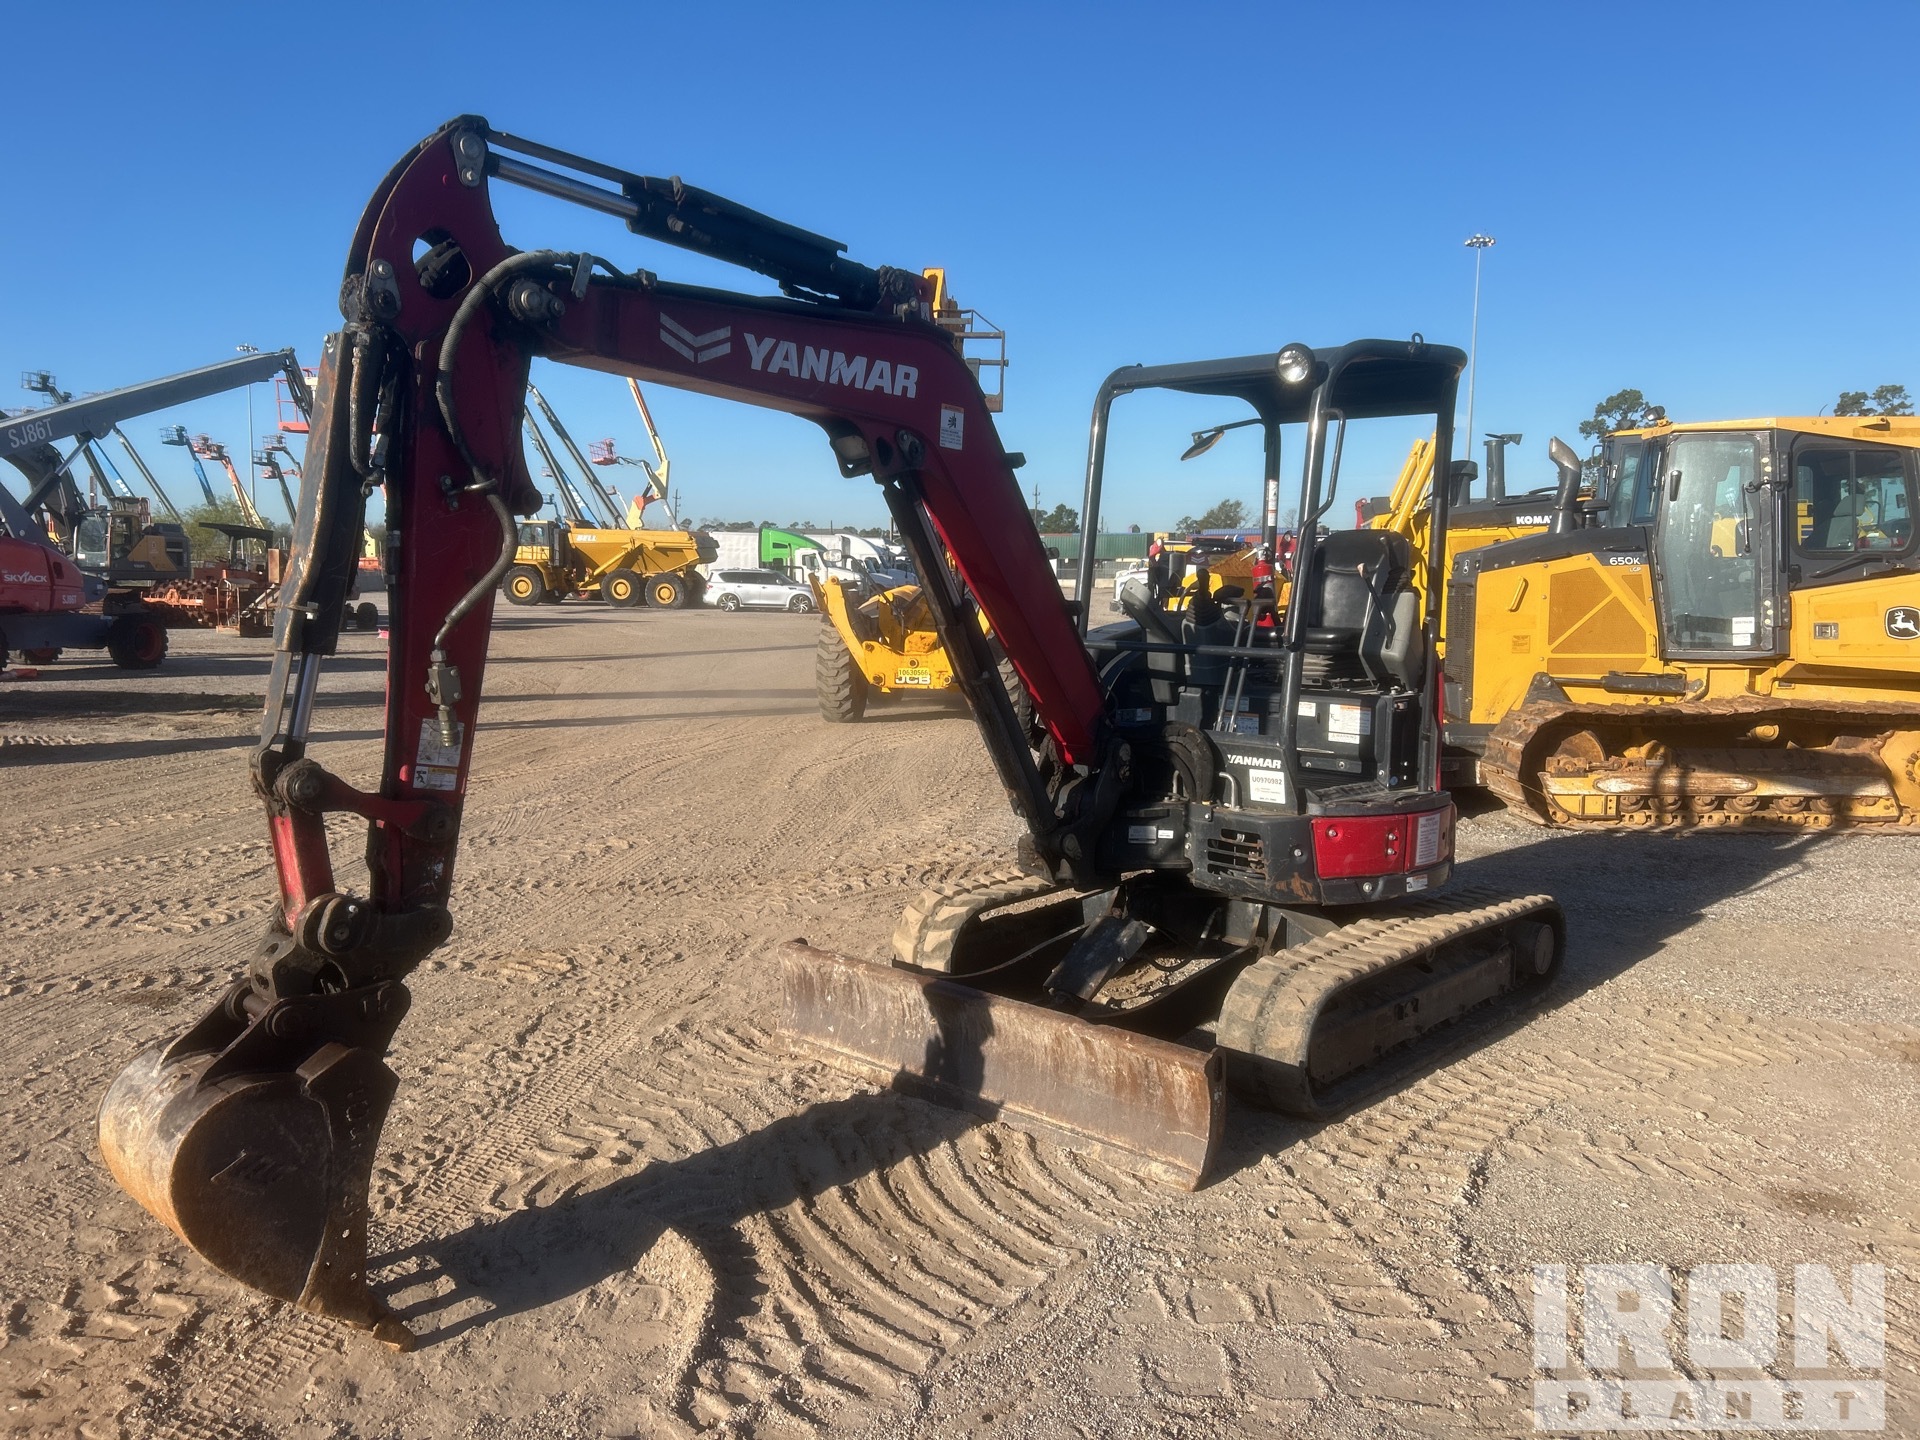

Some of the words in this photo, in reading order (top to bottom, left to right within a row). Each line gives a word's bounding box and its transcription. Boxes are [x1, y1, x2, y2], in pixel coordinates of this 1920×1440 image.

[743, 332, 919, 399] YANMAR
[8, 418, 53, 449] SJ86T
[1516, 515, 1552, 525] KOMA
[1609, 557, 1641, 566] 650K
[3, 571, 48, 584] SKYJACK
[1227, 754, 1282, 770] YANMAR
[1251, 776, 1283, 786] U0970982
